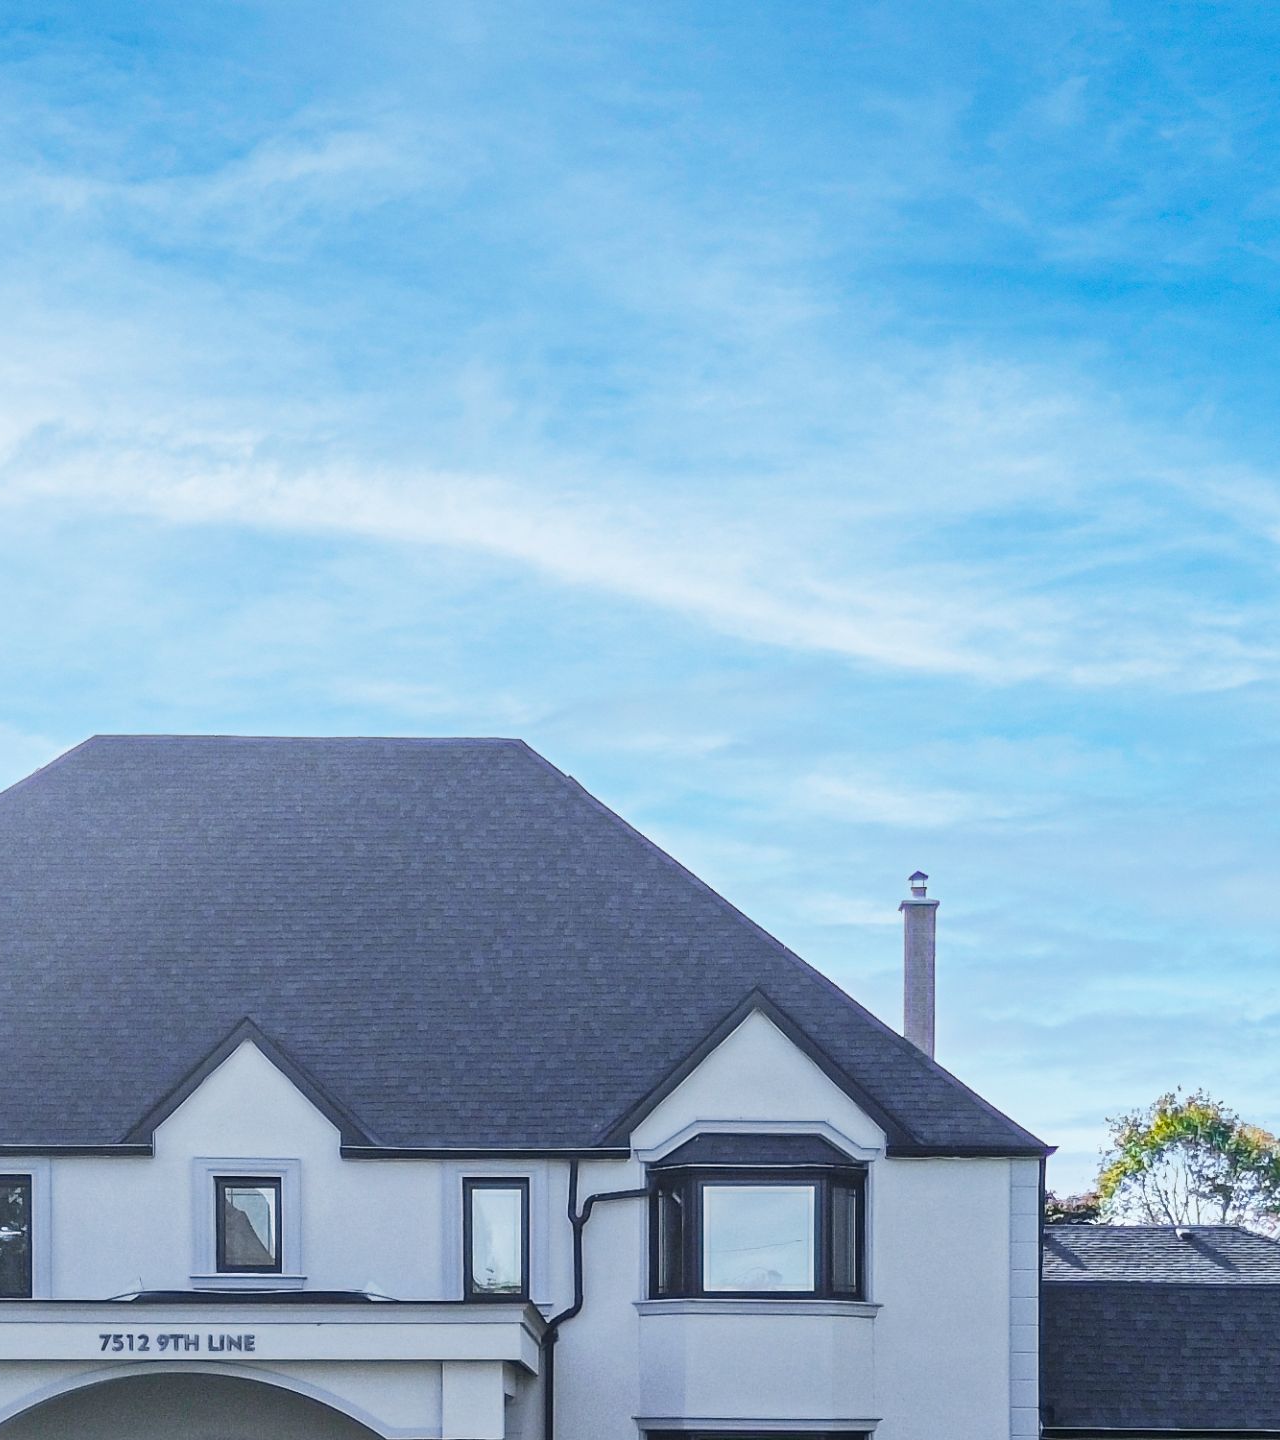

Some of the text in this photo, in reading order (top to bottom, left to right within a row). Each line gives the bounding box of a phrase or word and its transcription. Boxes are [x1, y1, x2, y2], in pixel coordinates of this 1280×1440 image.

[99, 1334, 256, 1352] 7512 9TH LINE
